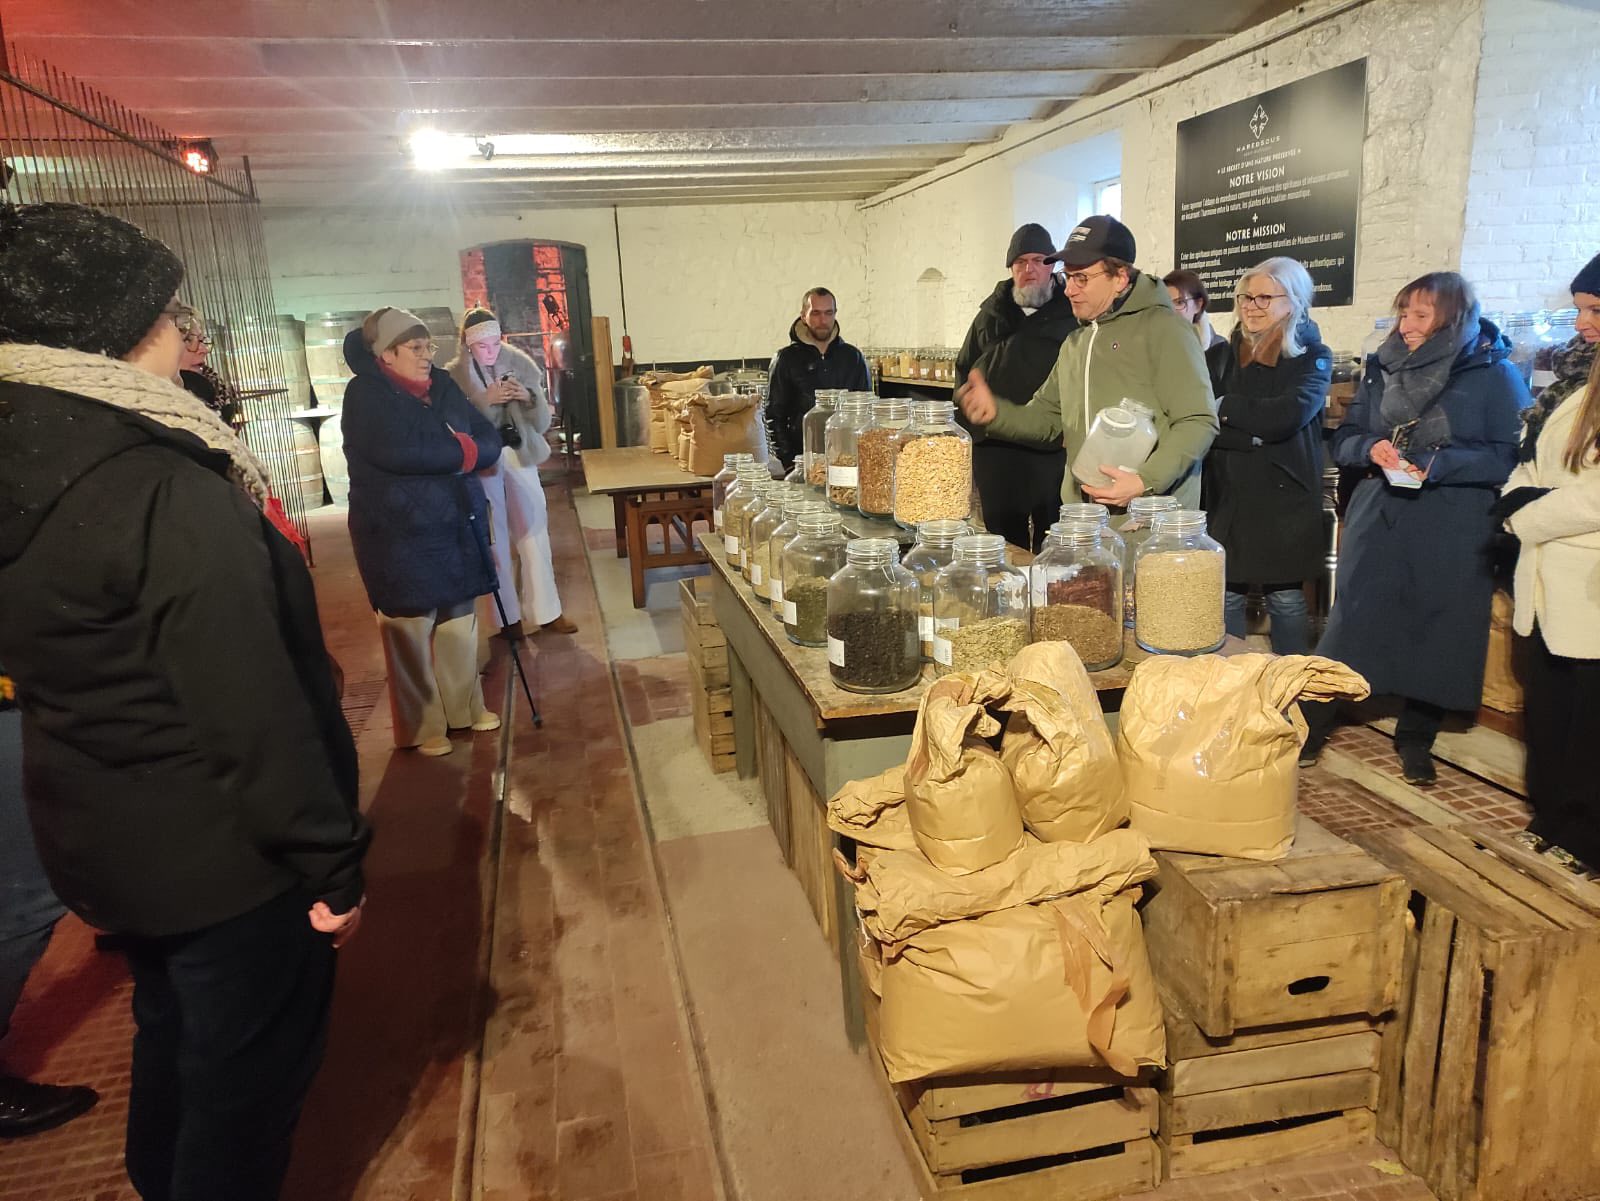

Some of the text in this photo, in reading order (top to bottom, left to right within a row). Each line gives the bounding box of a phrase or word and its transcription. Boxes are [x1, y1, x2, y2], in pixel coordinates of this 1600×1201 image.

[1229, 165, 1284, 187] NOTRE VISION
[1225, 223, 1285, 241] NOTRE MISSION
